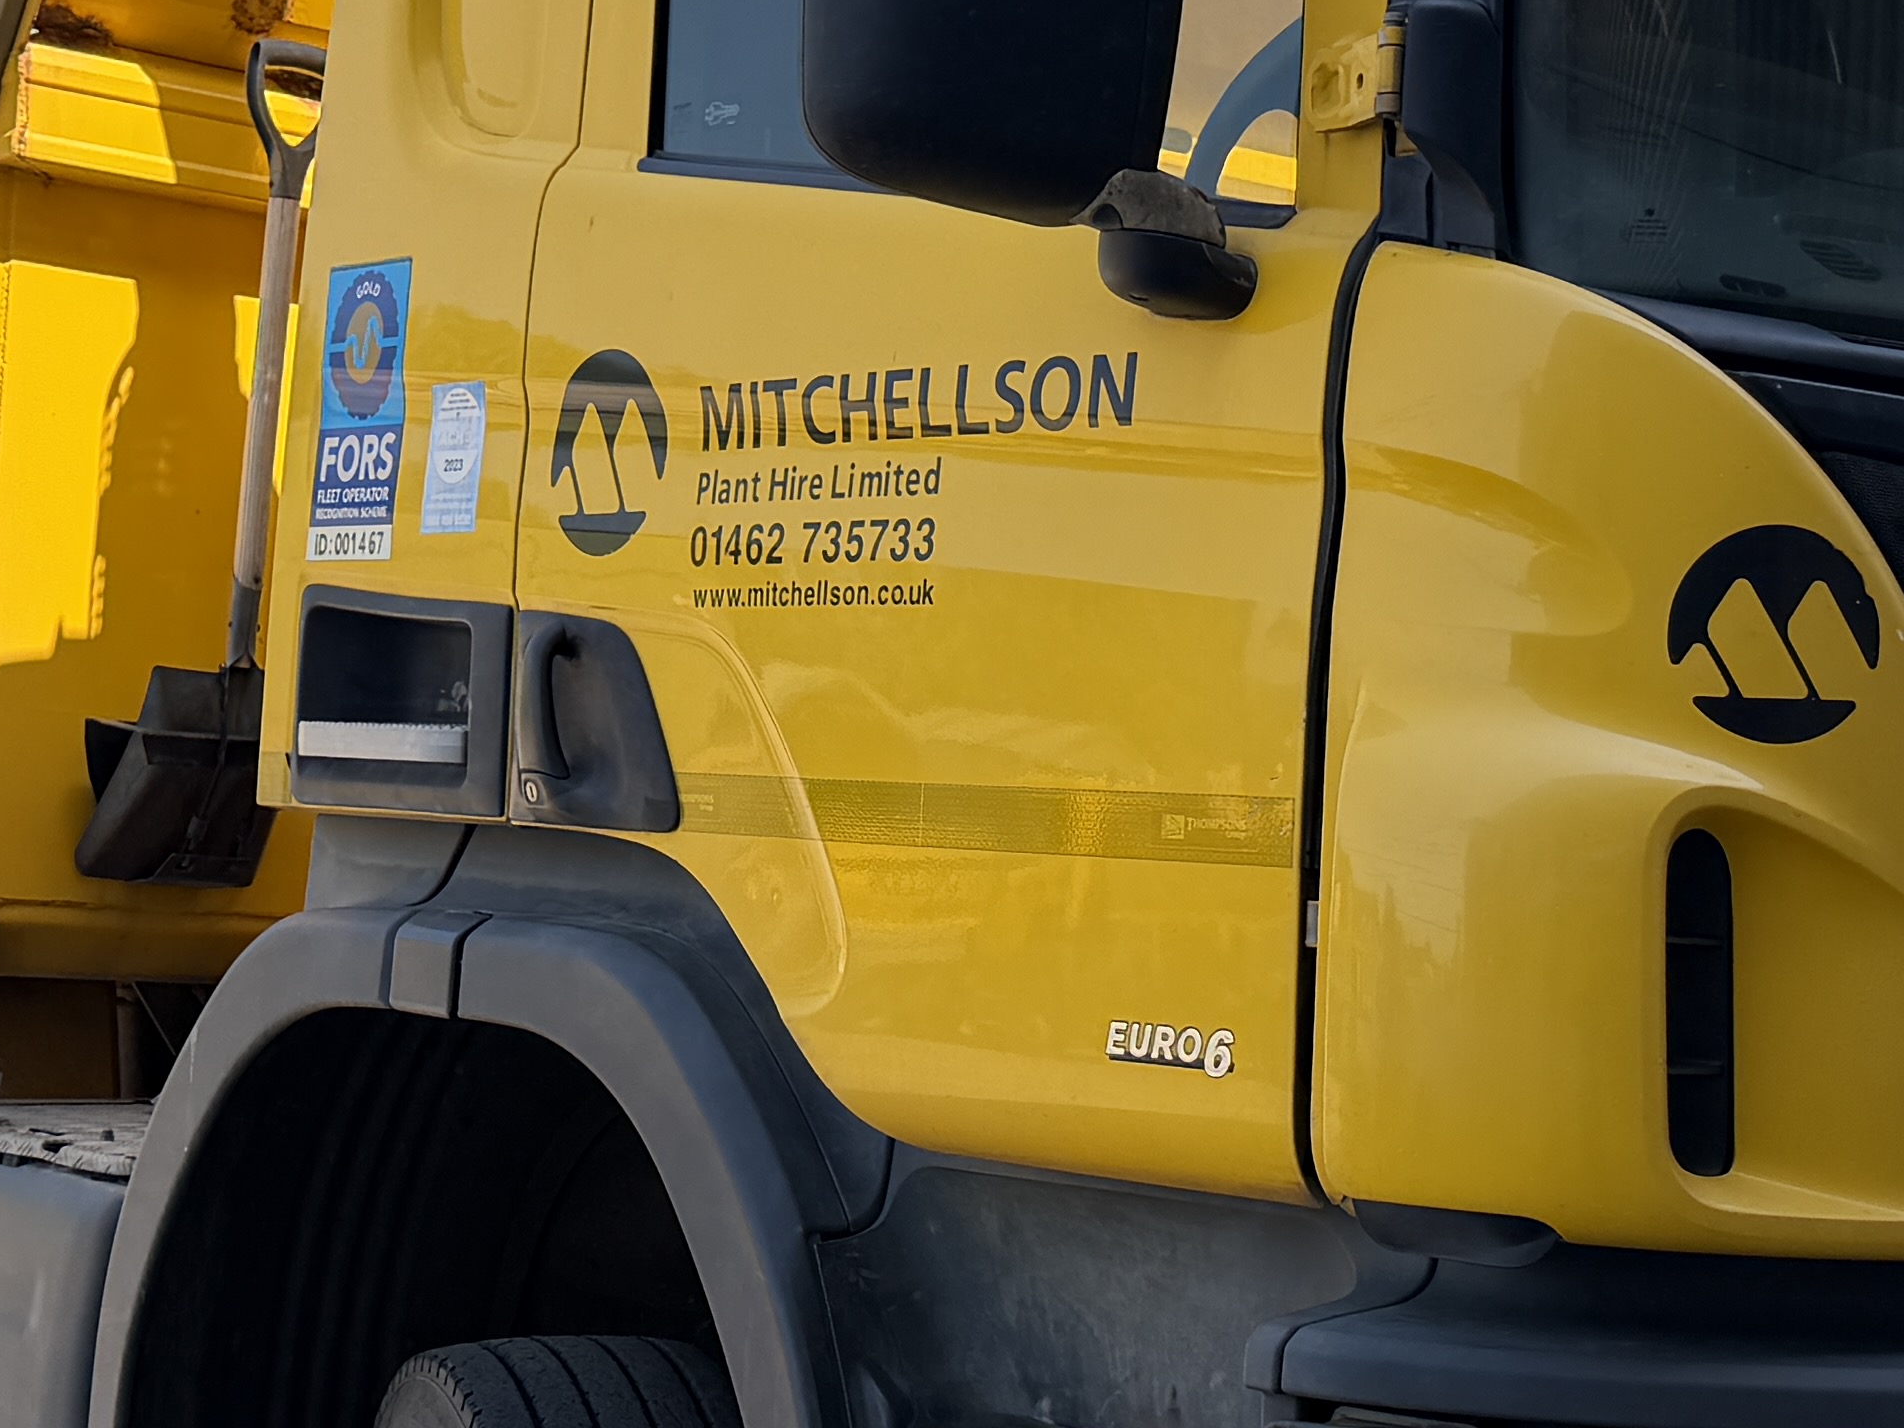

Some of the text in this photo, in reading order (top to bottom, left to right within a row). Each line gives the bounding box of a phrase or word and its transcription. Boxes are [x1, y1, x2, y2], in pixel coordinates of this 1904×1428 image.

[356, 281, 381, 299] GOLD
[700, 352, 1138, 452] MITCHELLSON
[320, 432, 396, 482] FORS
[697, 456, 942, 506] Plant Hire Limited
[317, 486, 389, 503] FLEET OPERATOR
[690, 518, 935, 568] 01462 735733
[693, 578, 935, 610] www.mitchellson.co.uk
